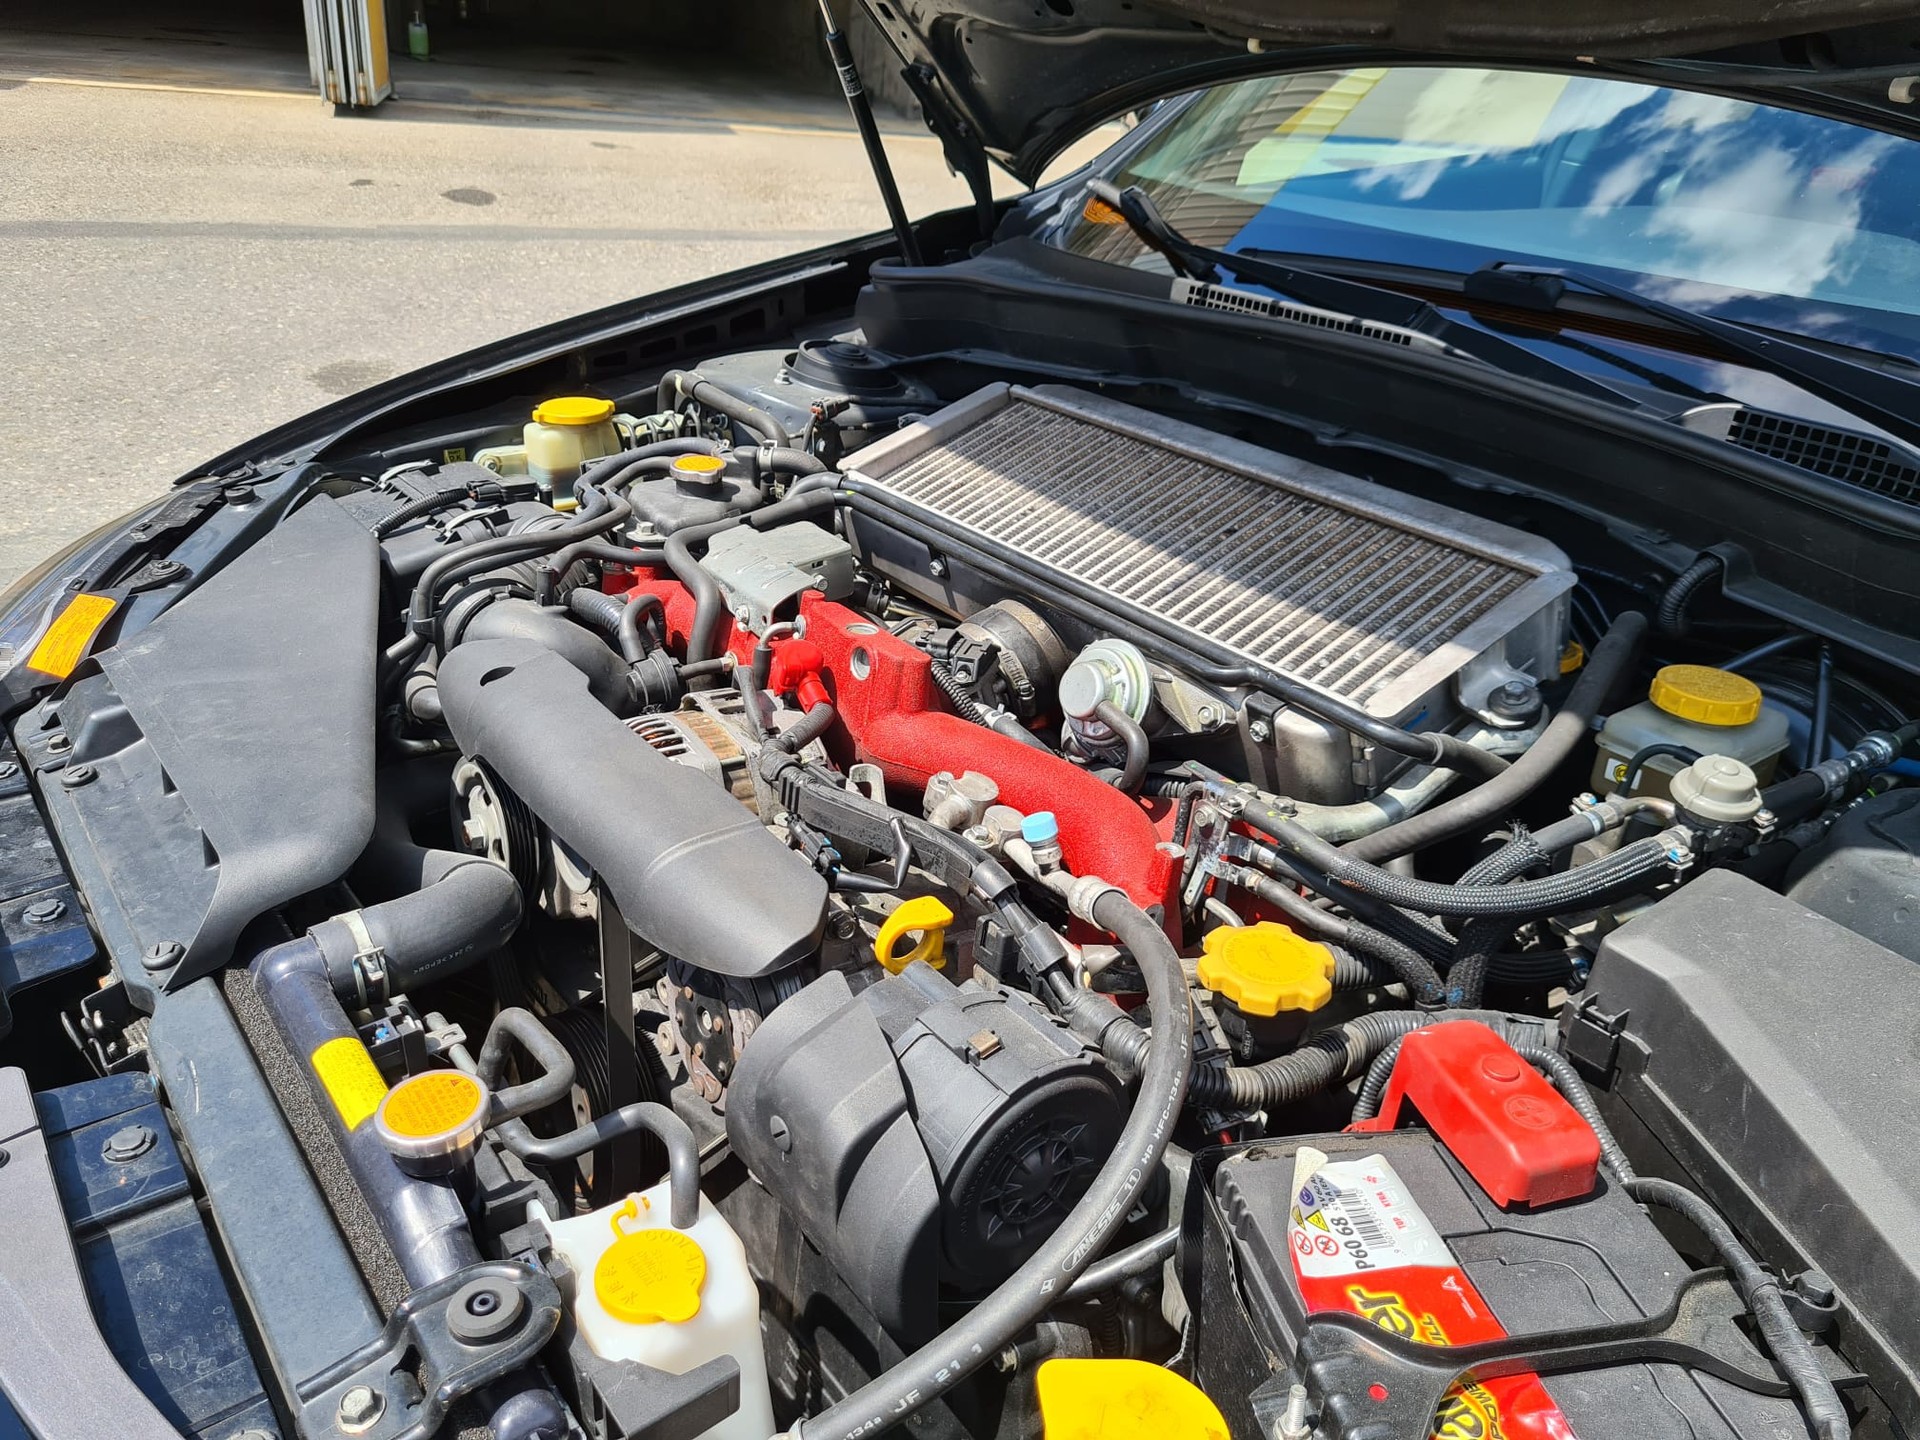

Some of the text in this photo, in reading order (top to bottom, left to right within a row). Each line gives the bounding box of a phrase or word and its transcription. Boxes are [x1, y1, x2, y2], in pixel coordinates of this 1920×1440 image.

[1141, 1144, 1154, 1164] HP
[1153, 1070, 1183, 1140] HFC-134a
[1181, 1033, 1189, 1059] JF
[1071, 1202, 1122, 1267] ANESIS
[1330, 1216, 1376, 1270] P60 68
[894, 1389, 921, 1414] JF
